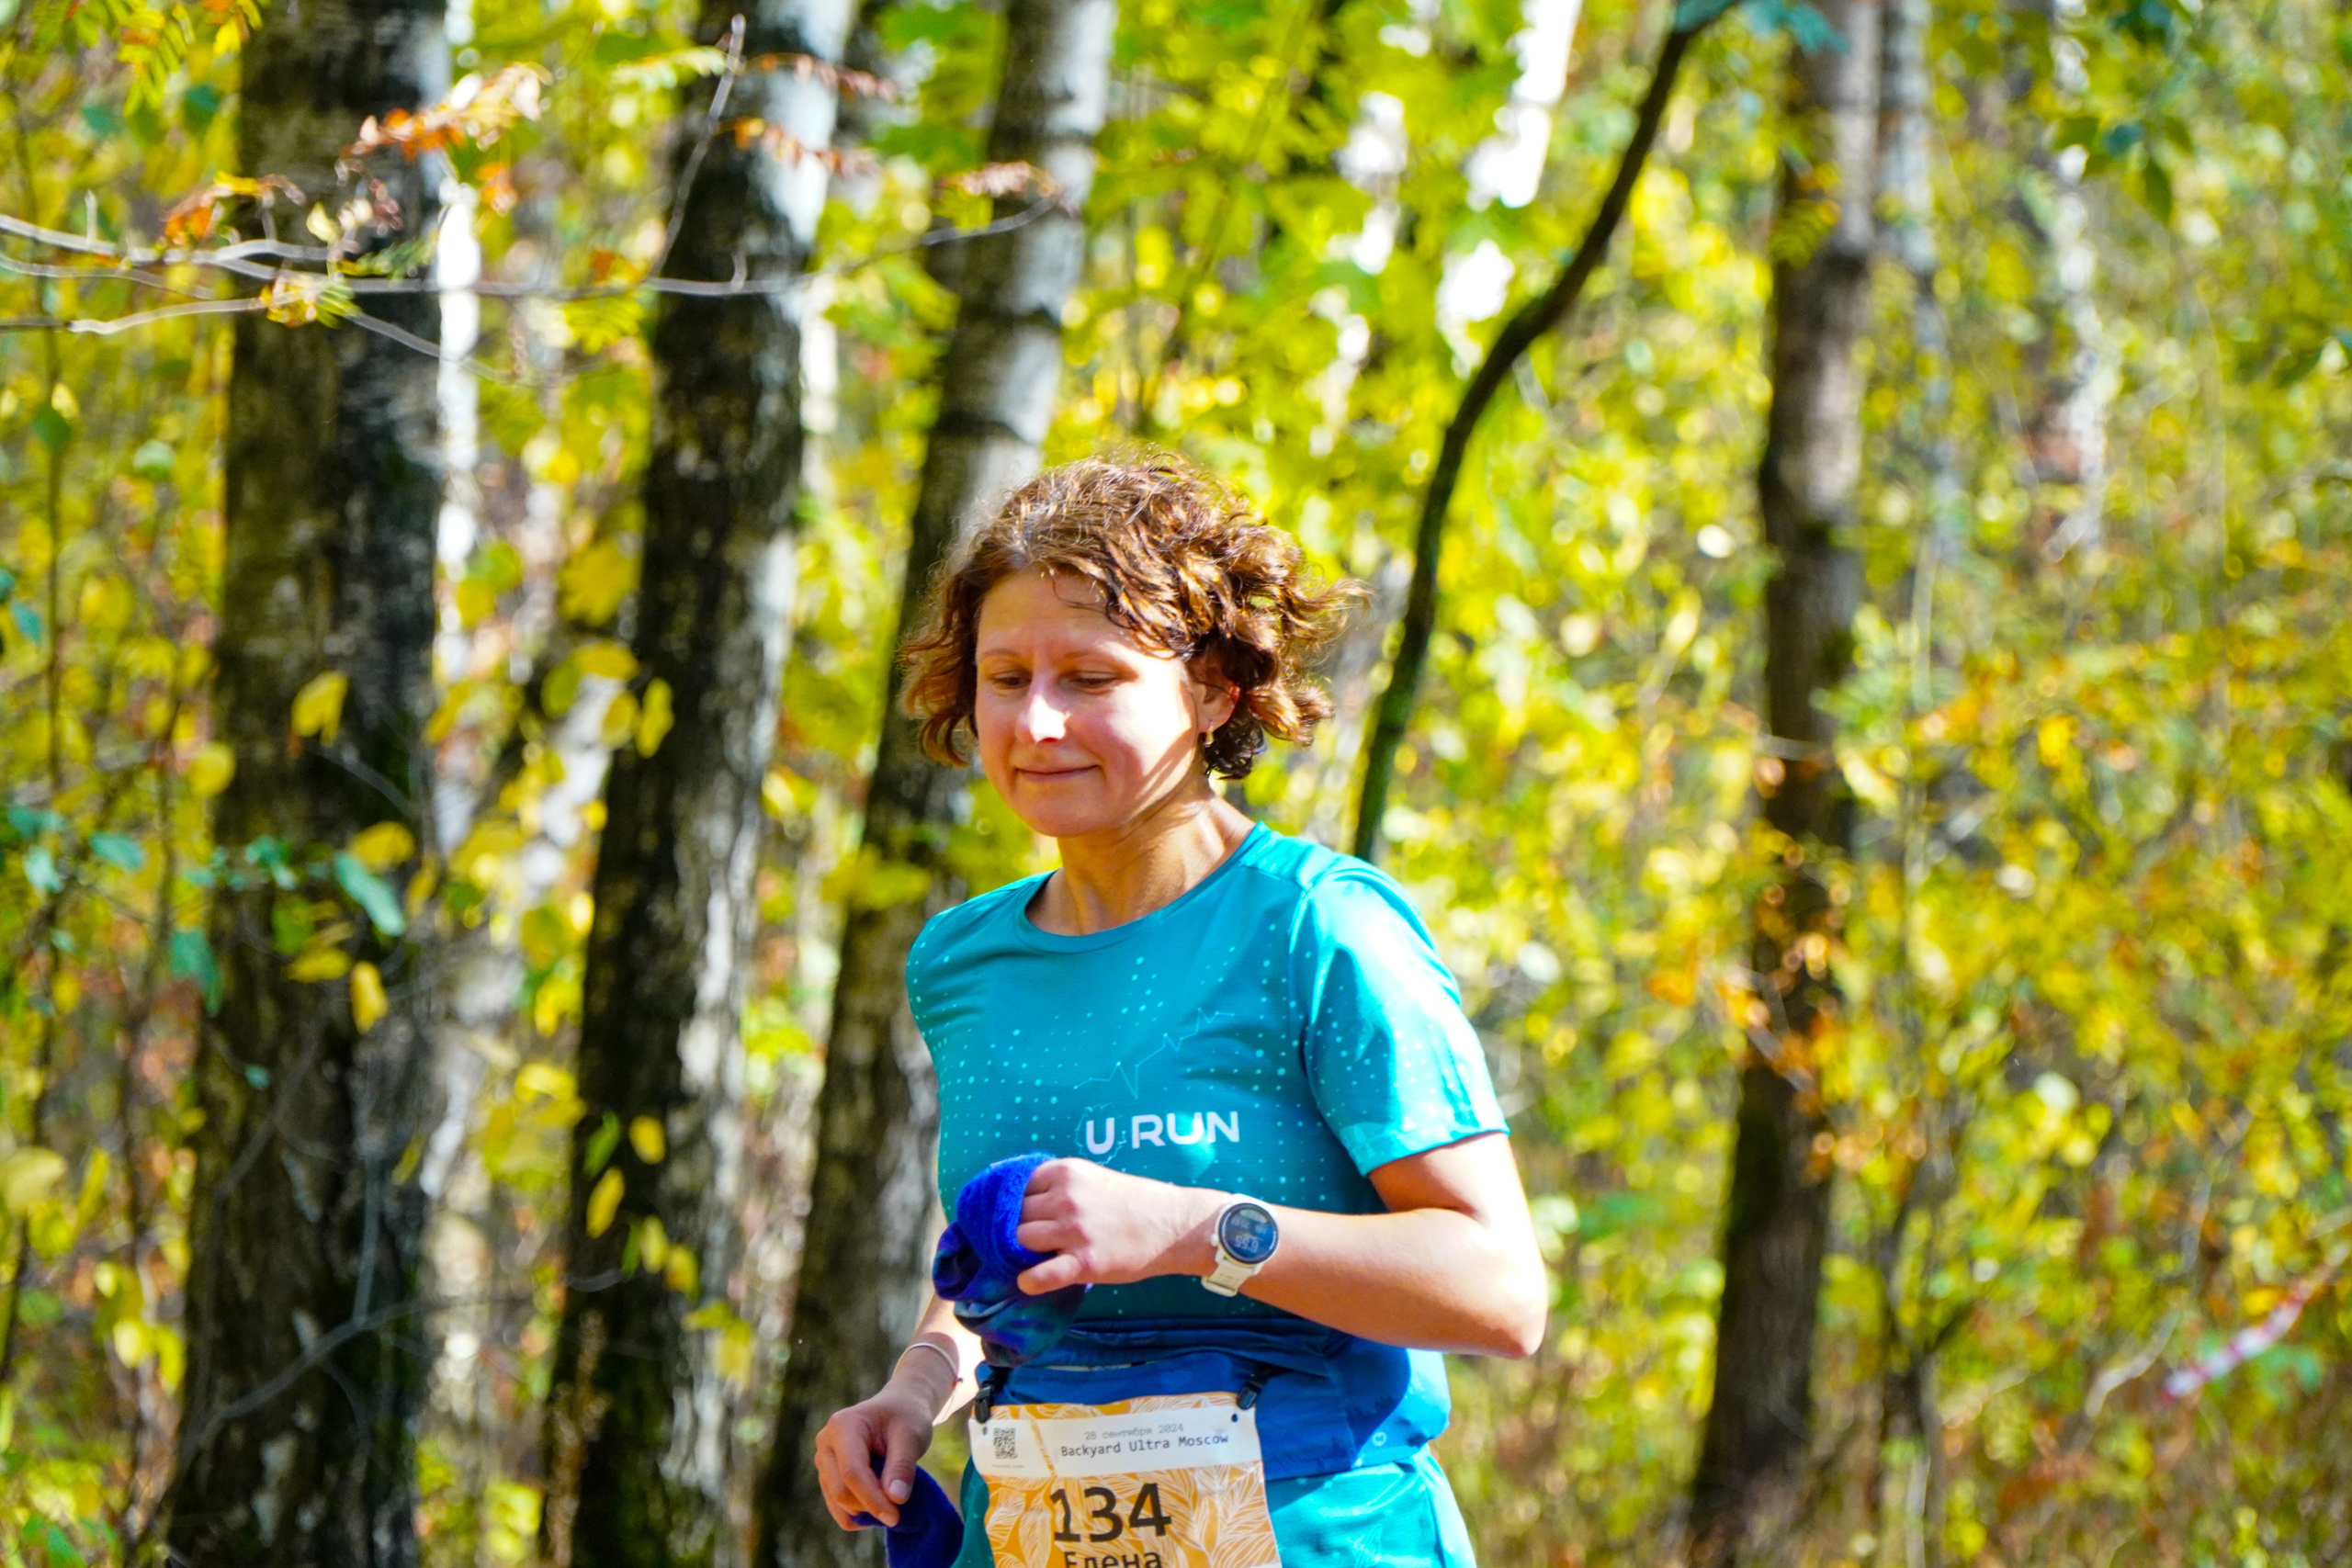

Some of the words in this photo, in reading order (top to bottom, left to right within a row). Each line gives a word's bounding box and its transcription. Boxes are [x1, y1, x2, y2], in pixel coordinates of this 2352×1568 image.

[1086, 1117, 1115, 1155] U
[1132, 1111, 1240, 1149] RUN
[1060, 1441, 1121, 1458] Backyard
[1129, 1438, 1170, 1452] Ultra
[1178, 1434, 1229, 1448] Moscow
[1083, 1430, 1098, 1441] 28
[1102, 1426, 1152, 1439] сентября
[1158, 1423, 1184, 1434] 2024
[1048, 1482, 1173, 1544] 134
